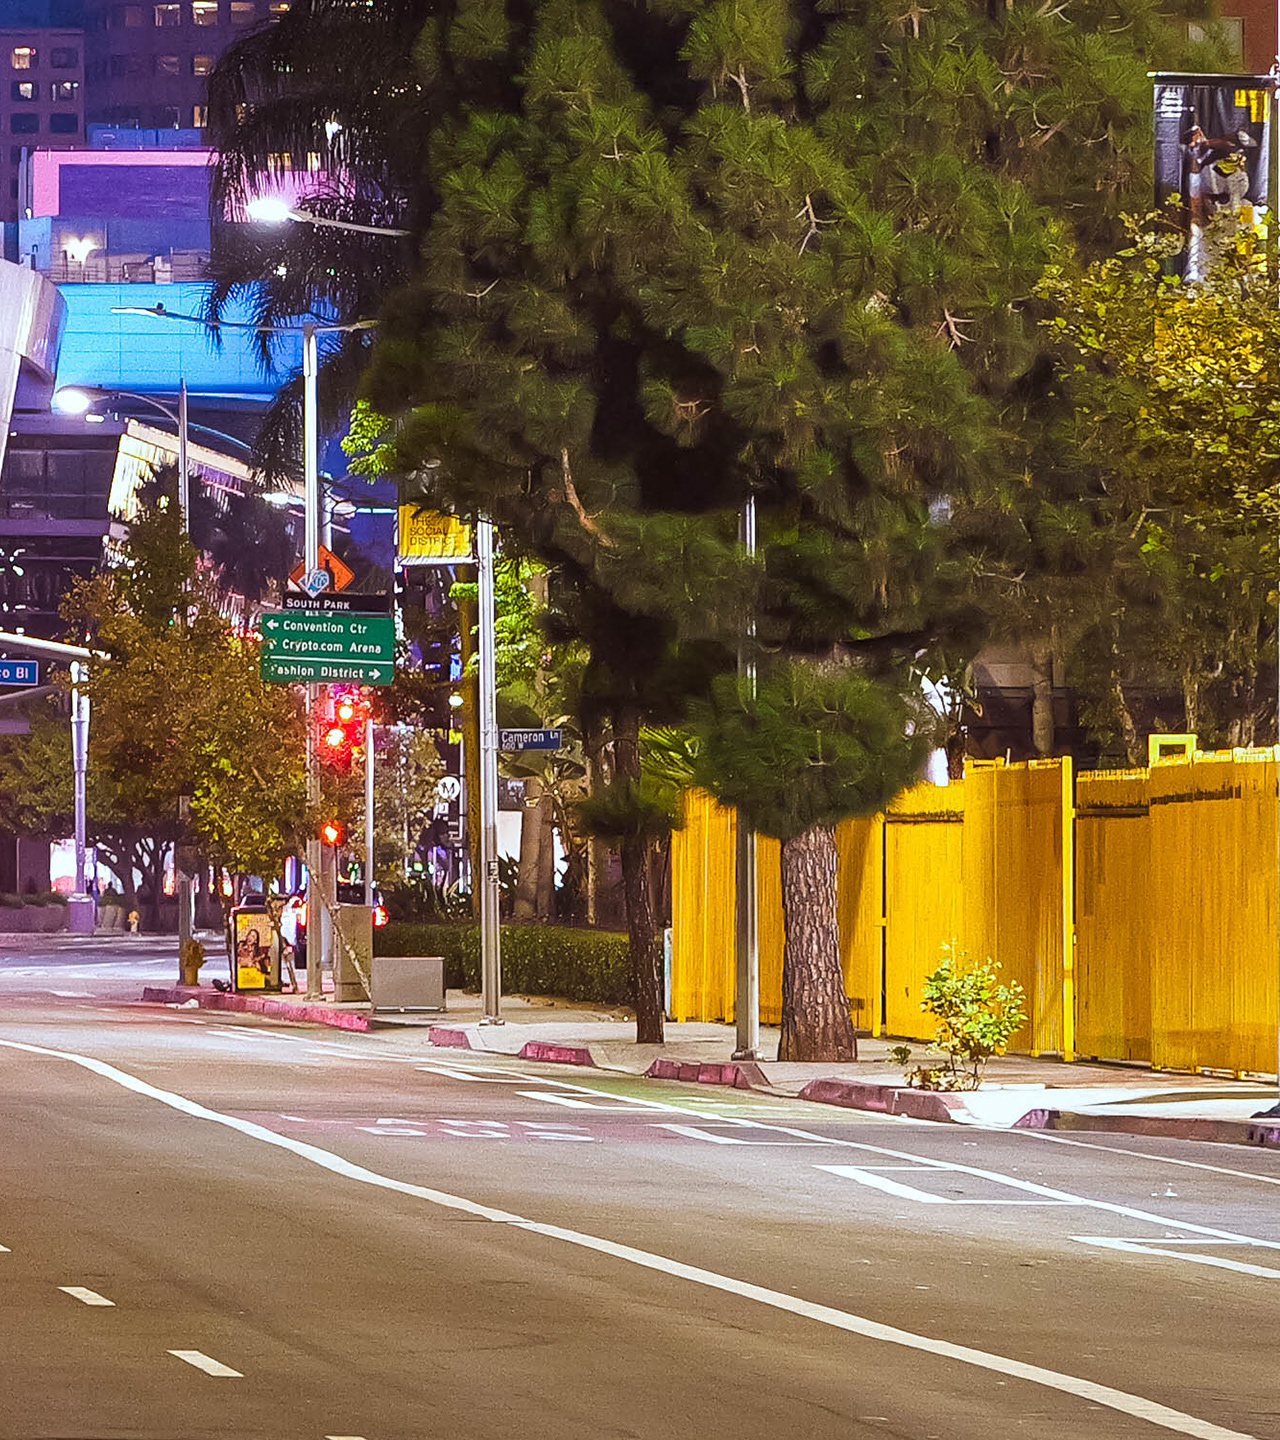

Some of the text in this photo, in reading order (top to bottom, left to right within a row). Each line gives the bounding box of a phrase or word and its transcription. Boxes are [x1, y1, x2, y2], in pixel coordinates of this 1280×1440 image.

[410, 526, 448, 536] SOCIAL
[283, 620, 368, 634] Convention Ctr
[282, 638, 382, 654] Crypto.com Arena
[321, 666, 364, 679] District
[501, 731, 559, 743] Cameron Ln
